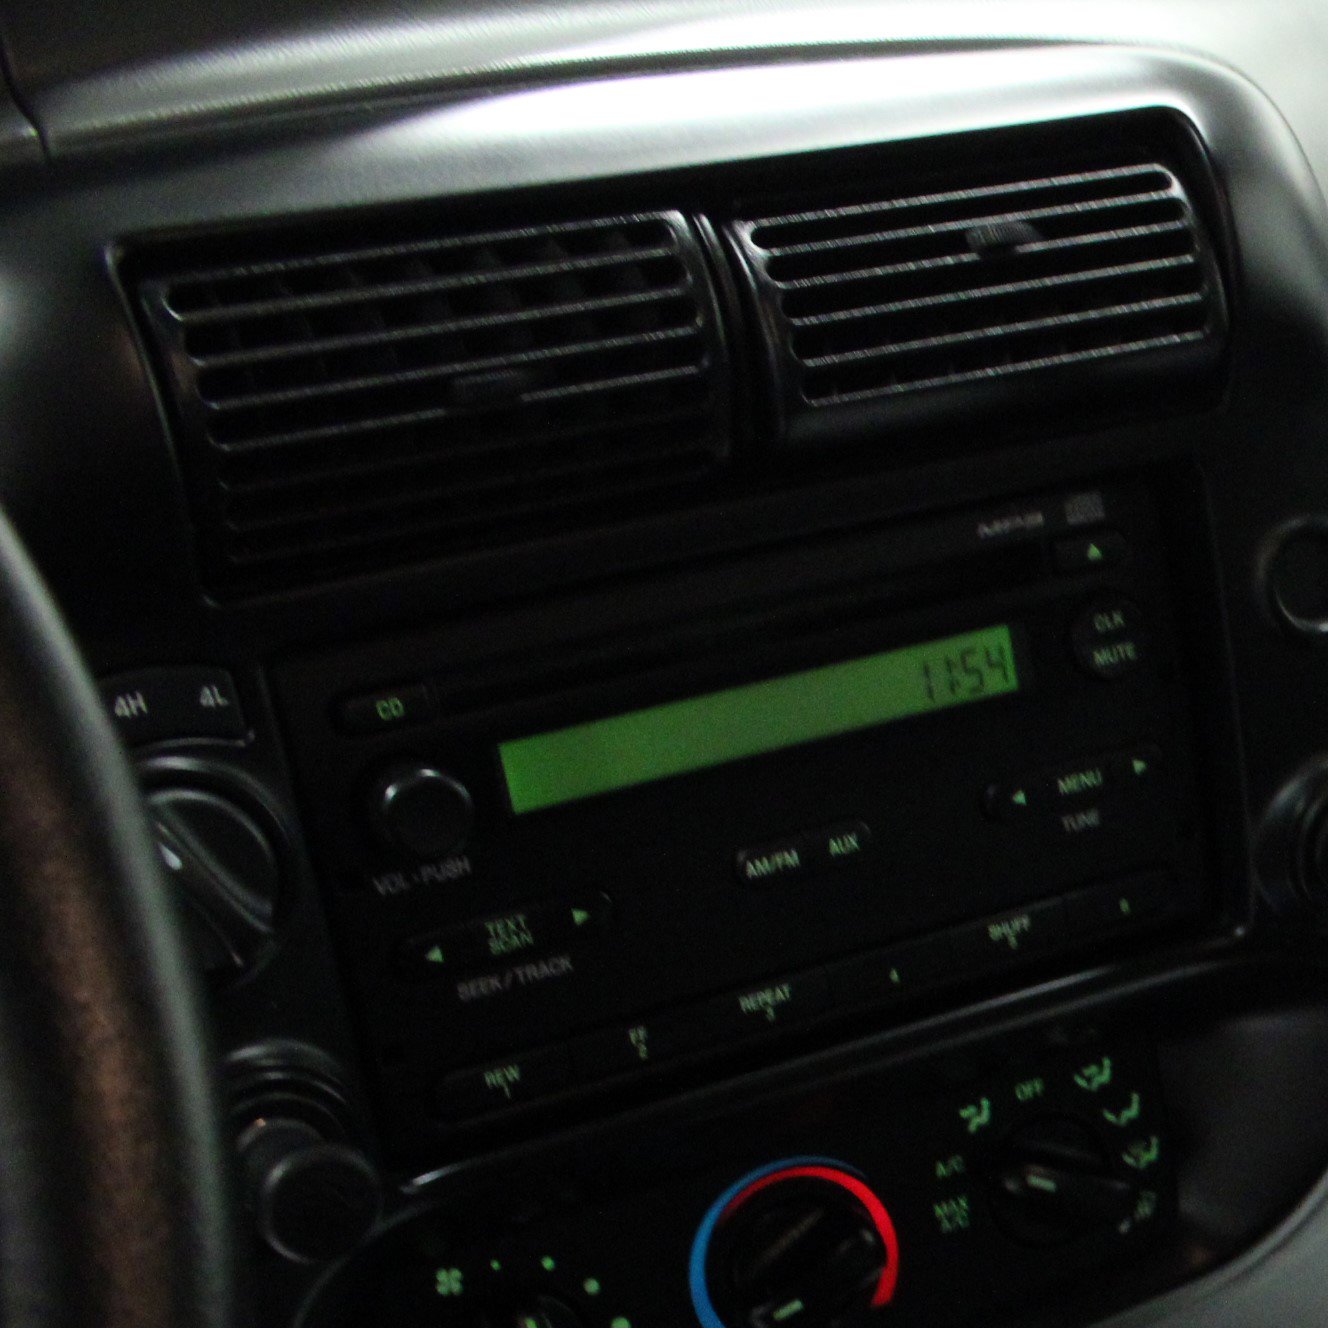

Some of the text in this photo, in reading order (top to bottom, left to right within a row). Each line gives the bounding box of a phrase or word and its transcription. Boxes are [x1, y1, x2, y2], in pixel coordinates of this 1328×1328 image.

[114, 690, 149, 719] 4H
[199, 684, 230, 709] 4L
[375, 697, 406, 722] CD
[1056, 767, 1104, 796] MENU
[828, 832, 861, 858] AUX
[745, 848, 801, 880] AM/FM
